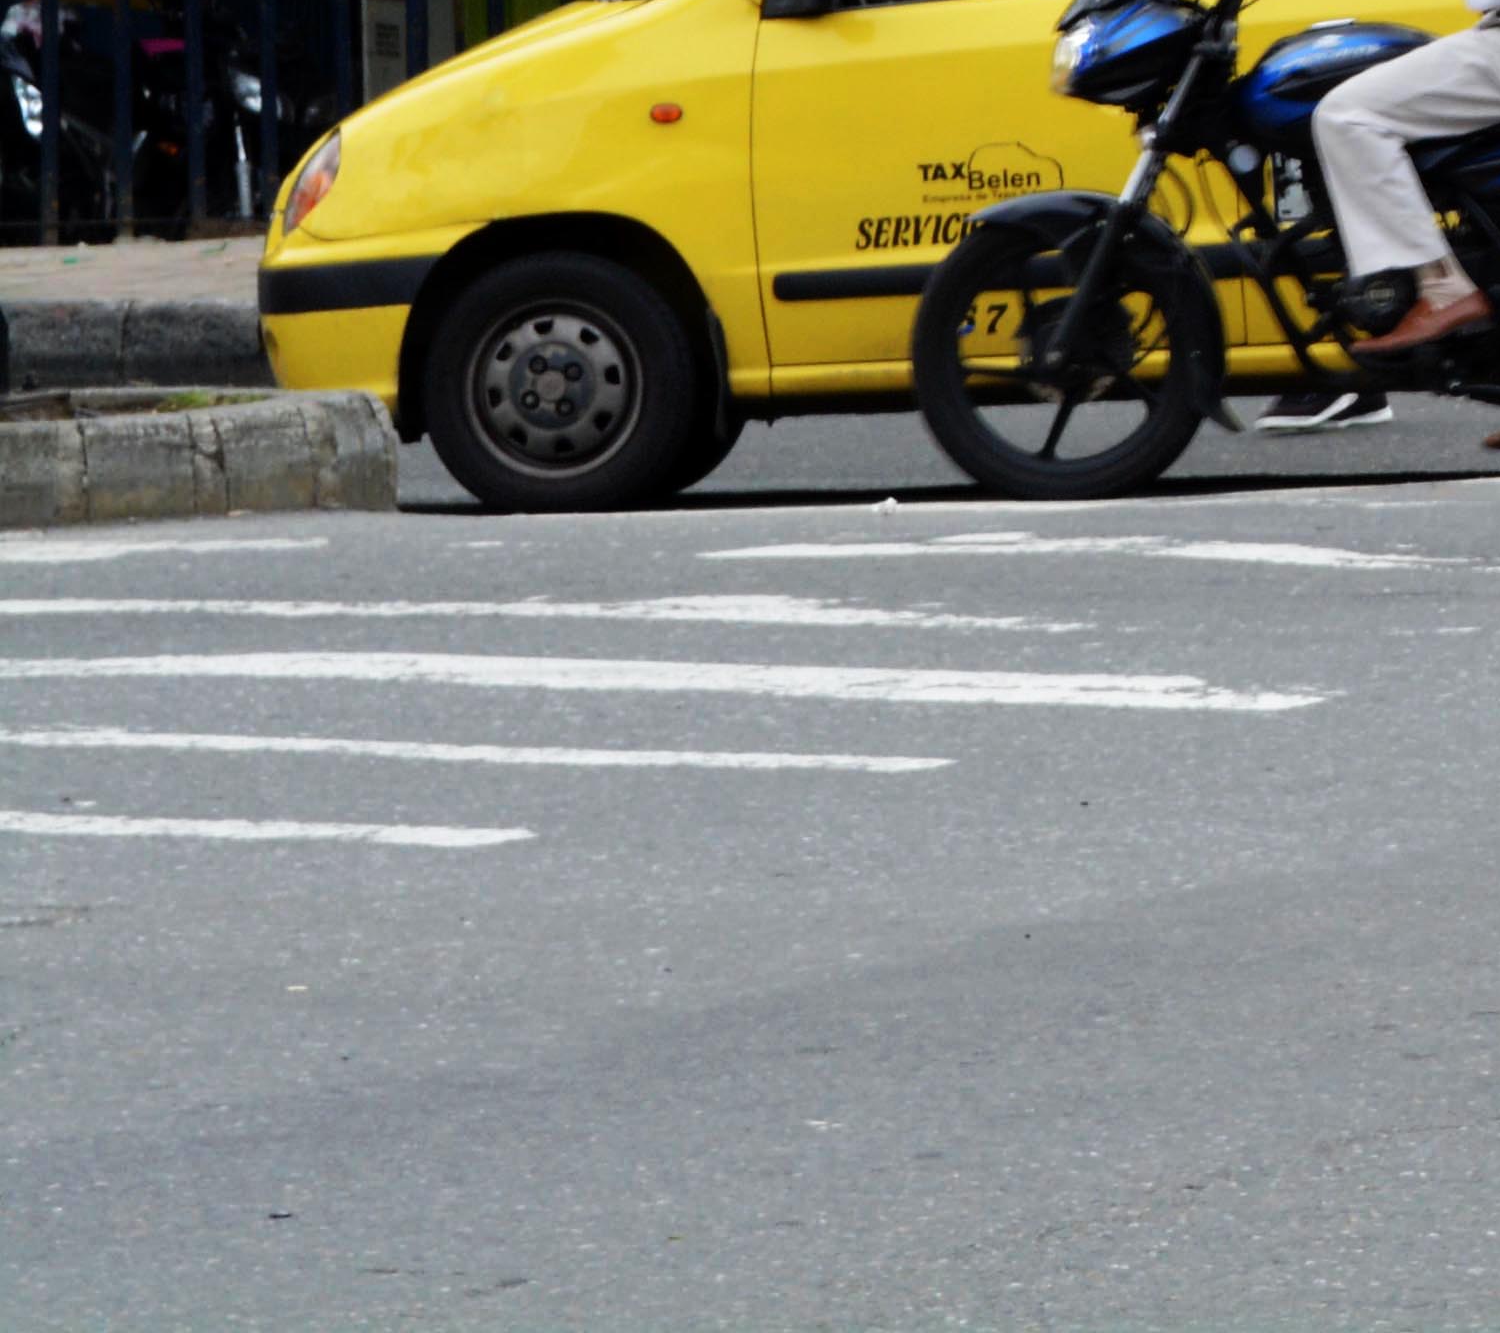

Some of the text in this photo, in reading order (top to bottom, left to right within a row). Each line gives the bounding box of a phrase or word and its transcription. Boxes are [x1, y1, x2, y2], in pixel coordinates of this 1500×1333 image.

[917, 161, 966, 182] TAX
[968, 168, 1042, 191] Belen
[855, 211, 987, 252] SERVICI
